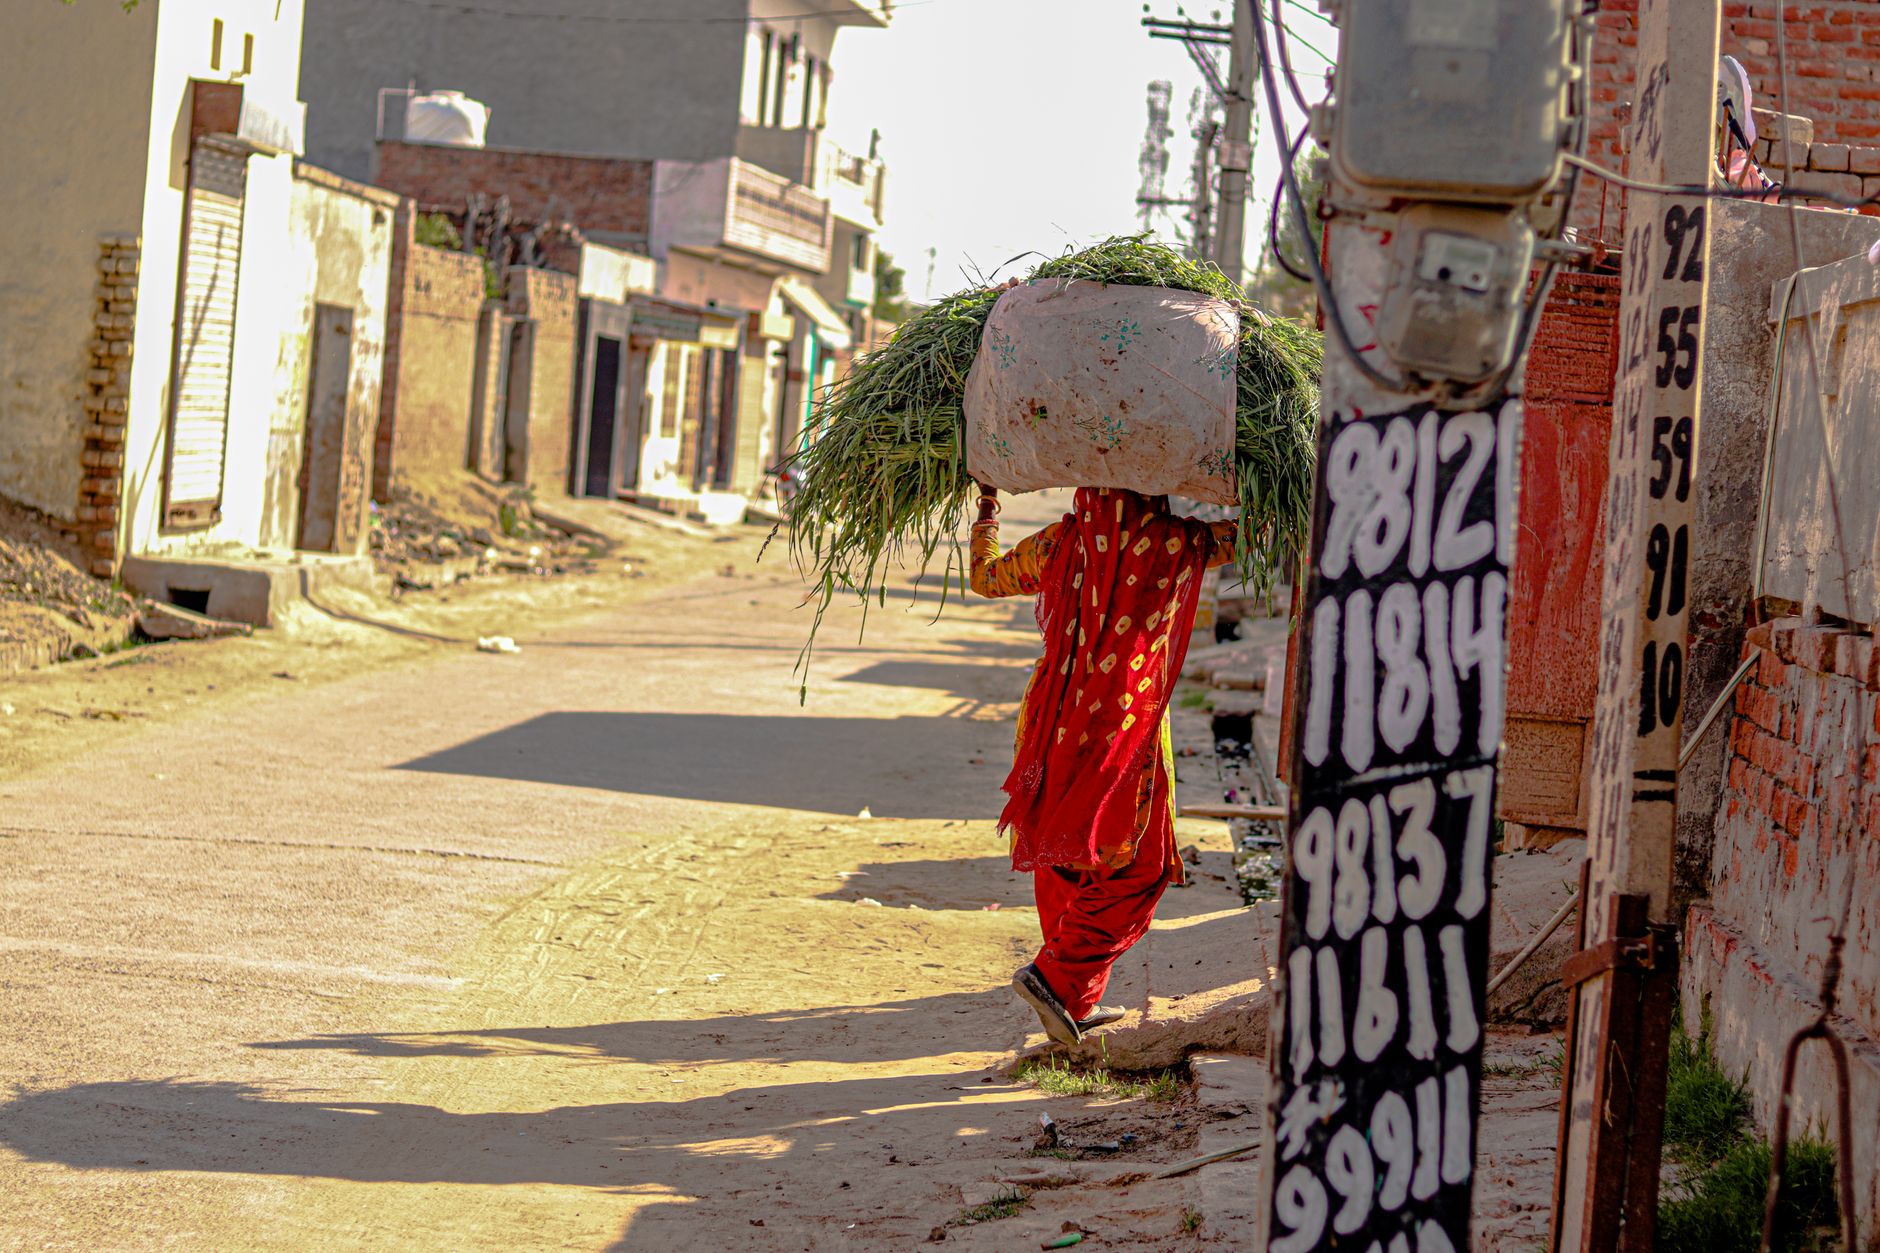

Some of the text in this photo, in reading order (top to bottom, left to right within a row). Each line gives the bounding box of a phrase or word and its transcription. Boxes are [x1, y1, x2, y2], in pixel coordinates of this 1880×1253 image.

[1664, 204, 1704, 283] 92
[1656, 304, 1700, 390] 55
[1320, 399, 1523, 579] 98121
[1649, 416, 1693, 502] 59
[1646, 523, 1689, 621] 91
[1303, 571, 1507, 773] 11814
[1637, 640, 1682, 737] 10
[1293, 765, 1494, 940] 98137
[1288, 924, 1480, 1086] 11611
[1268, 1065, 1472, 1253] 99911
